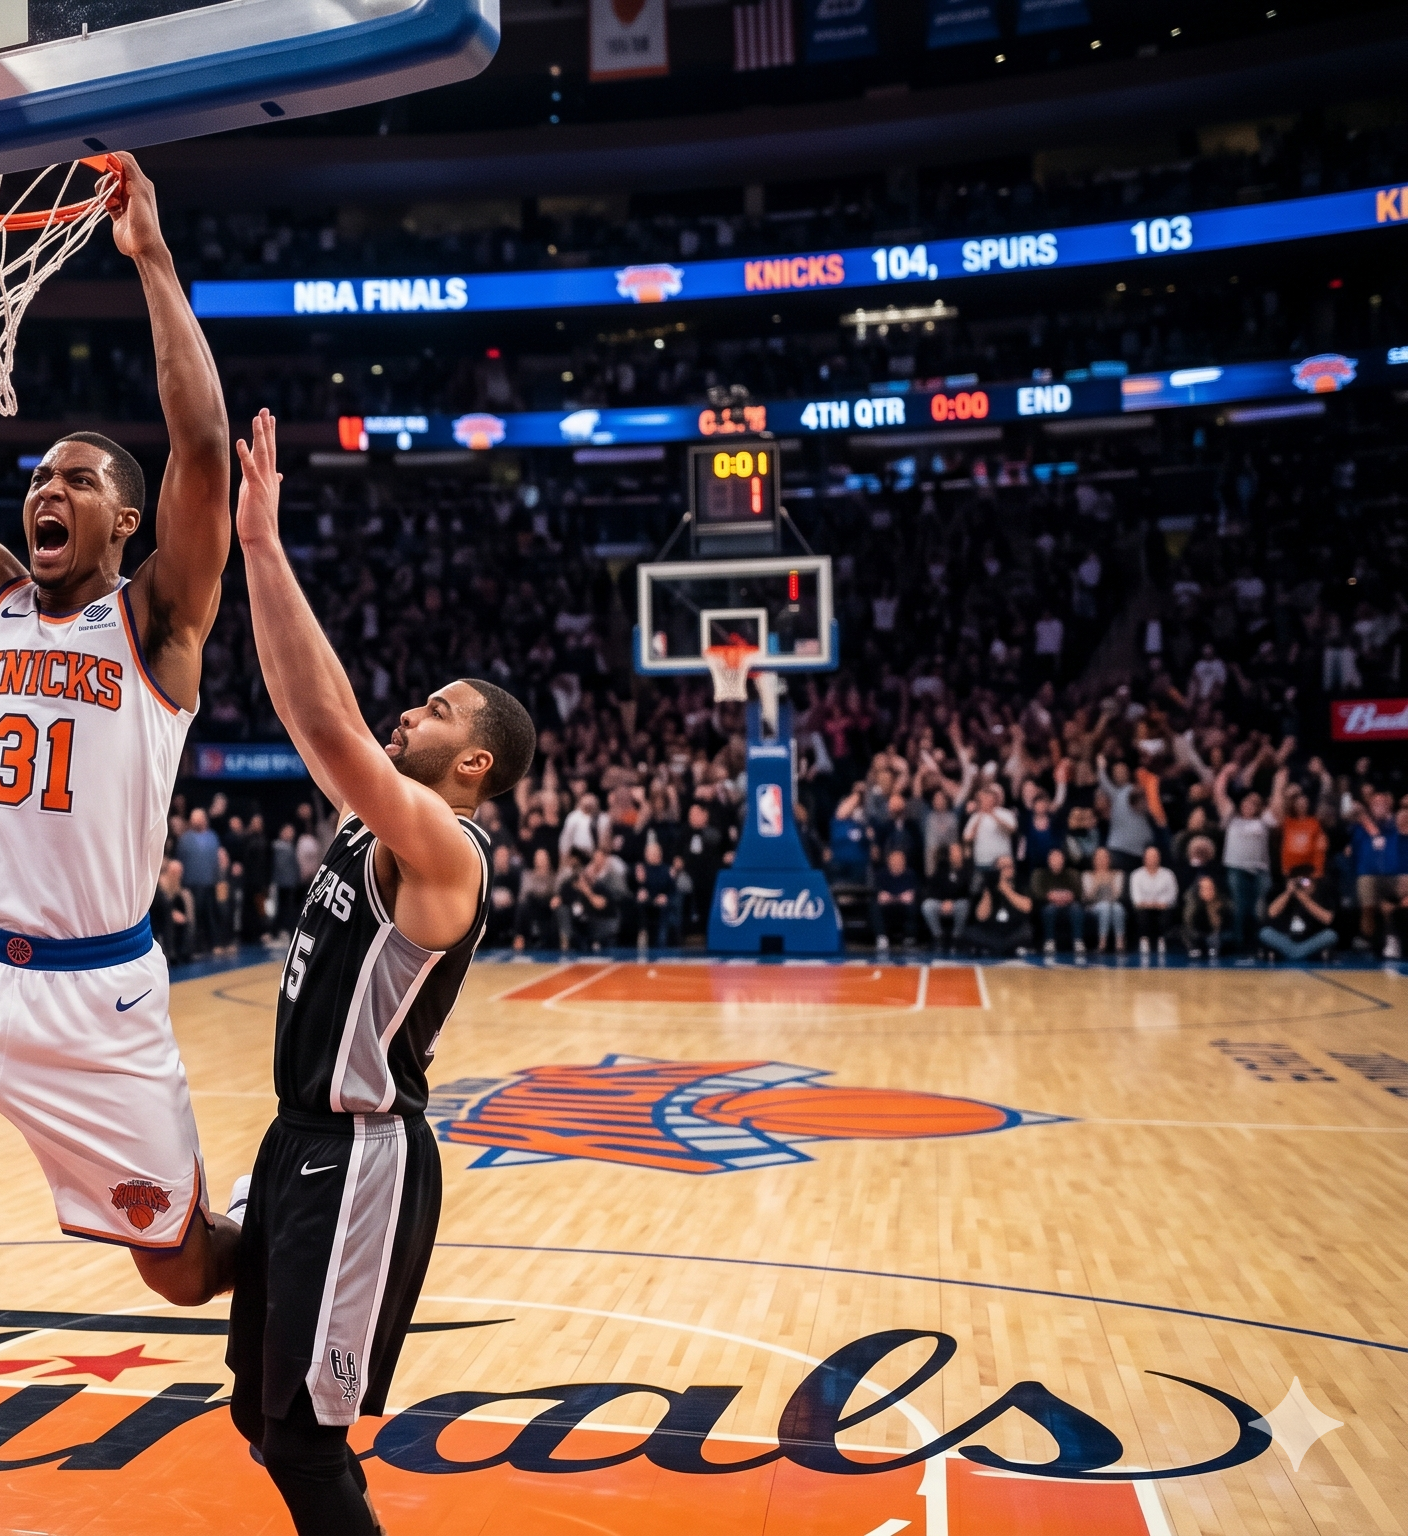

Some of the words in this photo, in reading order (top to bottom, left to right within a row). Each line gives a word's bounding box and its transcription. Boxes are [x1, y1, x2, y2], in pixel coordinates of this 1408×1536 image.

[293, 280, 358, 313] NBA
[361, 277, 469, 313] FINALS
[744, 253, 845, 291] KNICKS
[871, 245, 938, 281] 104,
[962, 232, 1058, 273] SPURS
[1130, 215, 1193, 254] 103
[800, 401, 850, 430] 4TH
[854, 396, 906, 428] QTR
[930, 391, 989, 421] 0:00
[1017, 384, 1072, 416] END
[712, 451, 768, 479] 0:01
[726, 886, 825, 927] Finals
[280, 926, 315, 1003] 5
